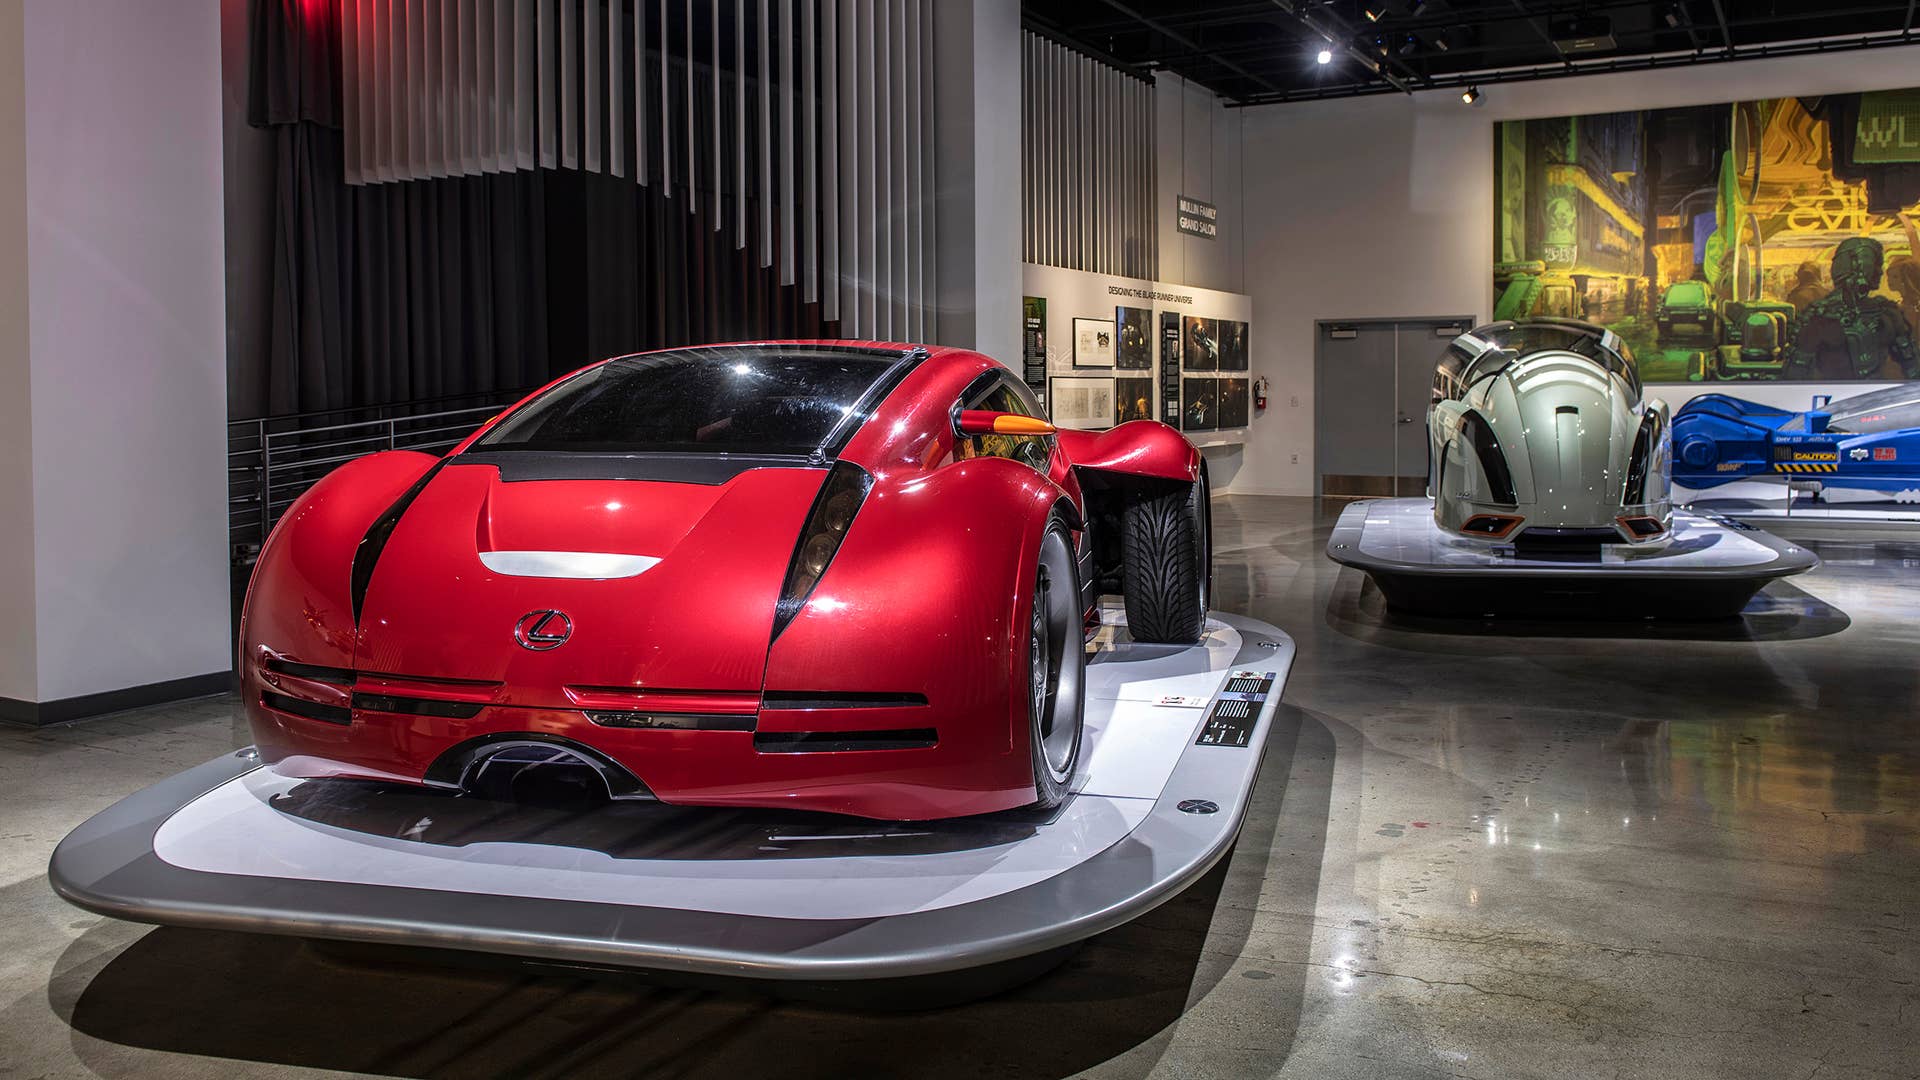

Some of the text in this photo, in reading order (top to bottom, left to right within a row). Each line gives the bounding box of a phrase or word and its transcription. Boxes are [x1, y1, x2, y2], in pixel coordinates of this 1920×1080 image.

[1180, 200, 1217, 220] MULLIN FAMILY
[1180, 216, 1216, 236] GRAND SALON
[1108, 285, 1193, 304] DESIGNING THE BLADE RUNNER UNIVERSE
[1793, 452, 1837, 461] CAUTION
